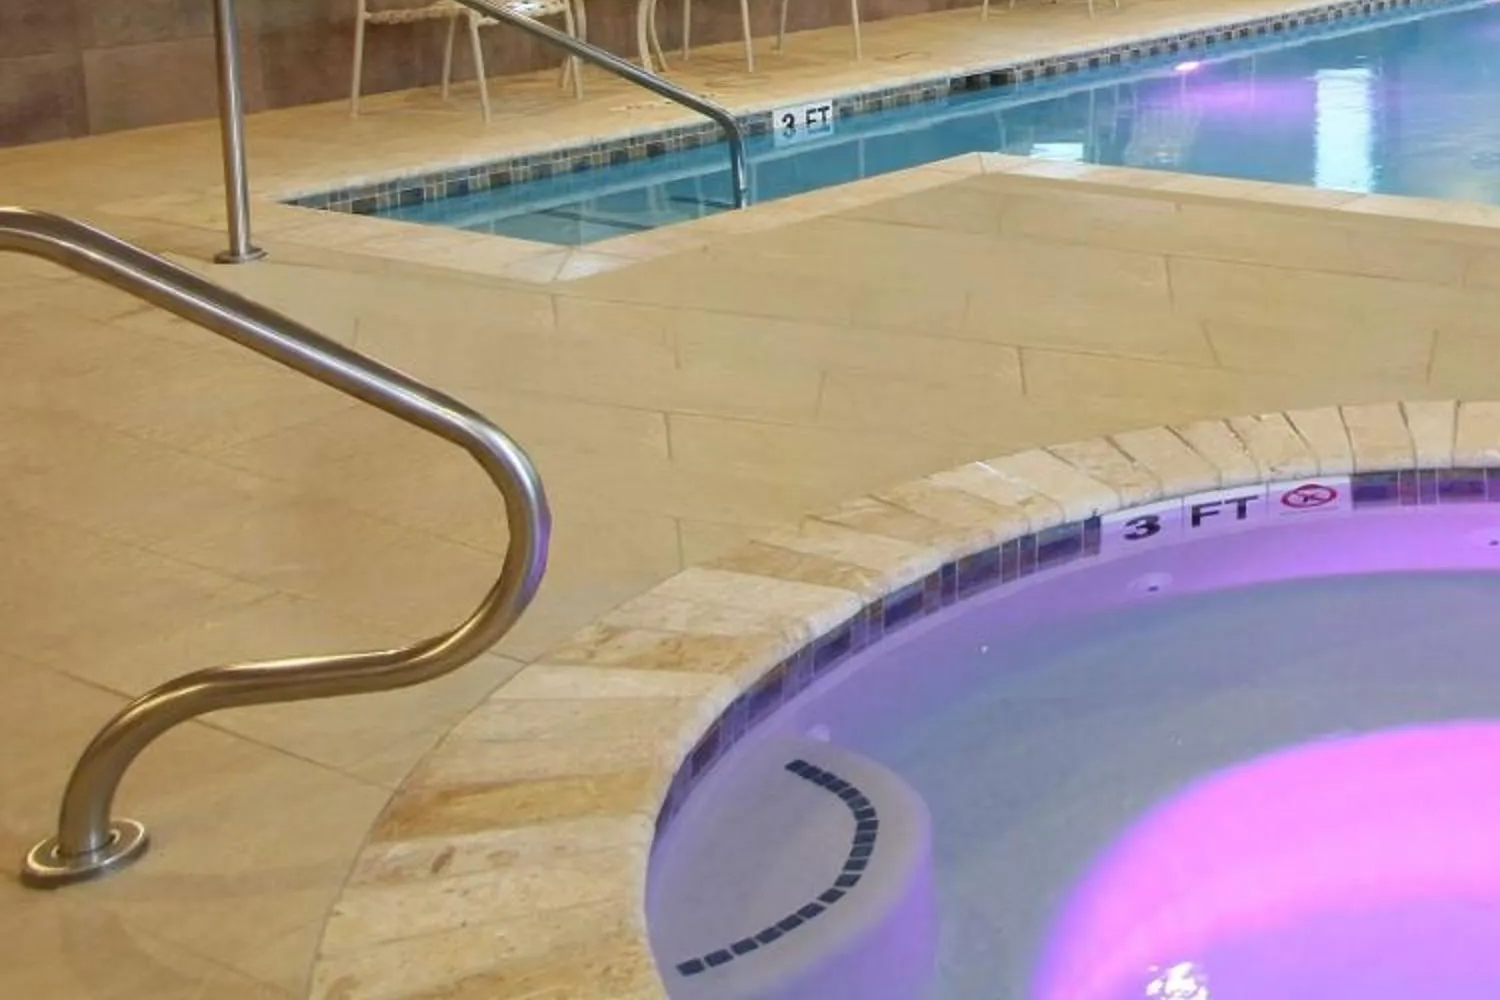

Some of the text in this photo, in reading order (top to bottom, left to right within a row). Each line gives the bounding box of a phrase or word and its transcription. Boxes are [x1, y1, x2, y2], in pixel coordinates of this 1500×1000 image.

[781, 105, 830, 138] 3 FT
[1123, 494, 1259, 541] 3 FT
